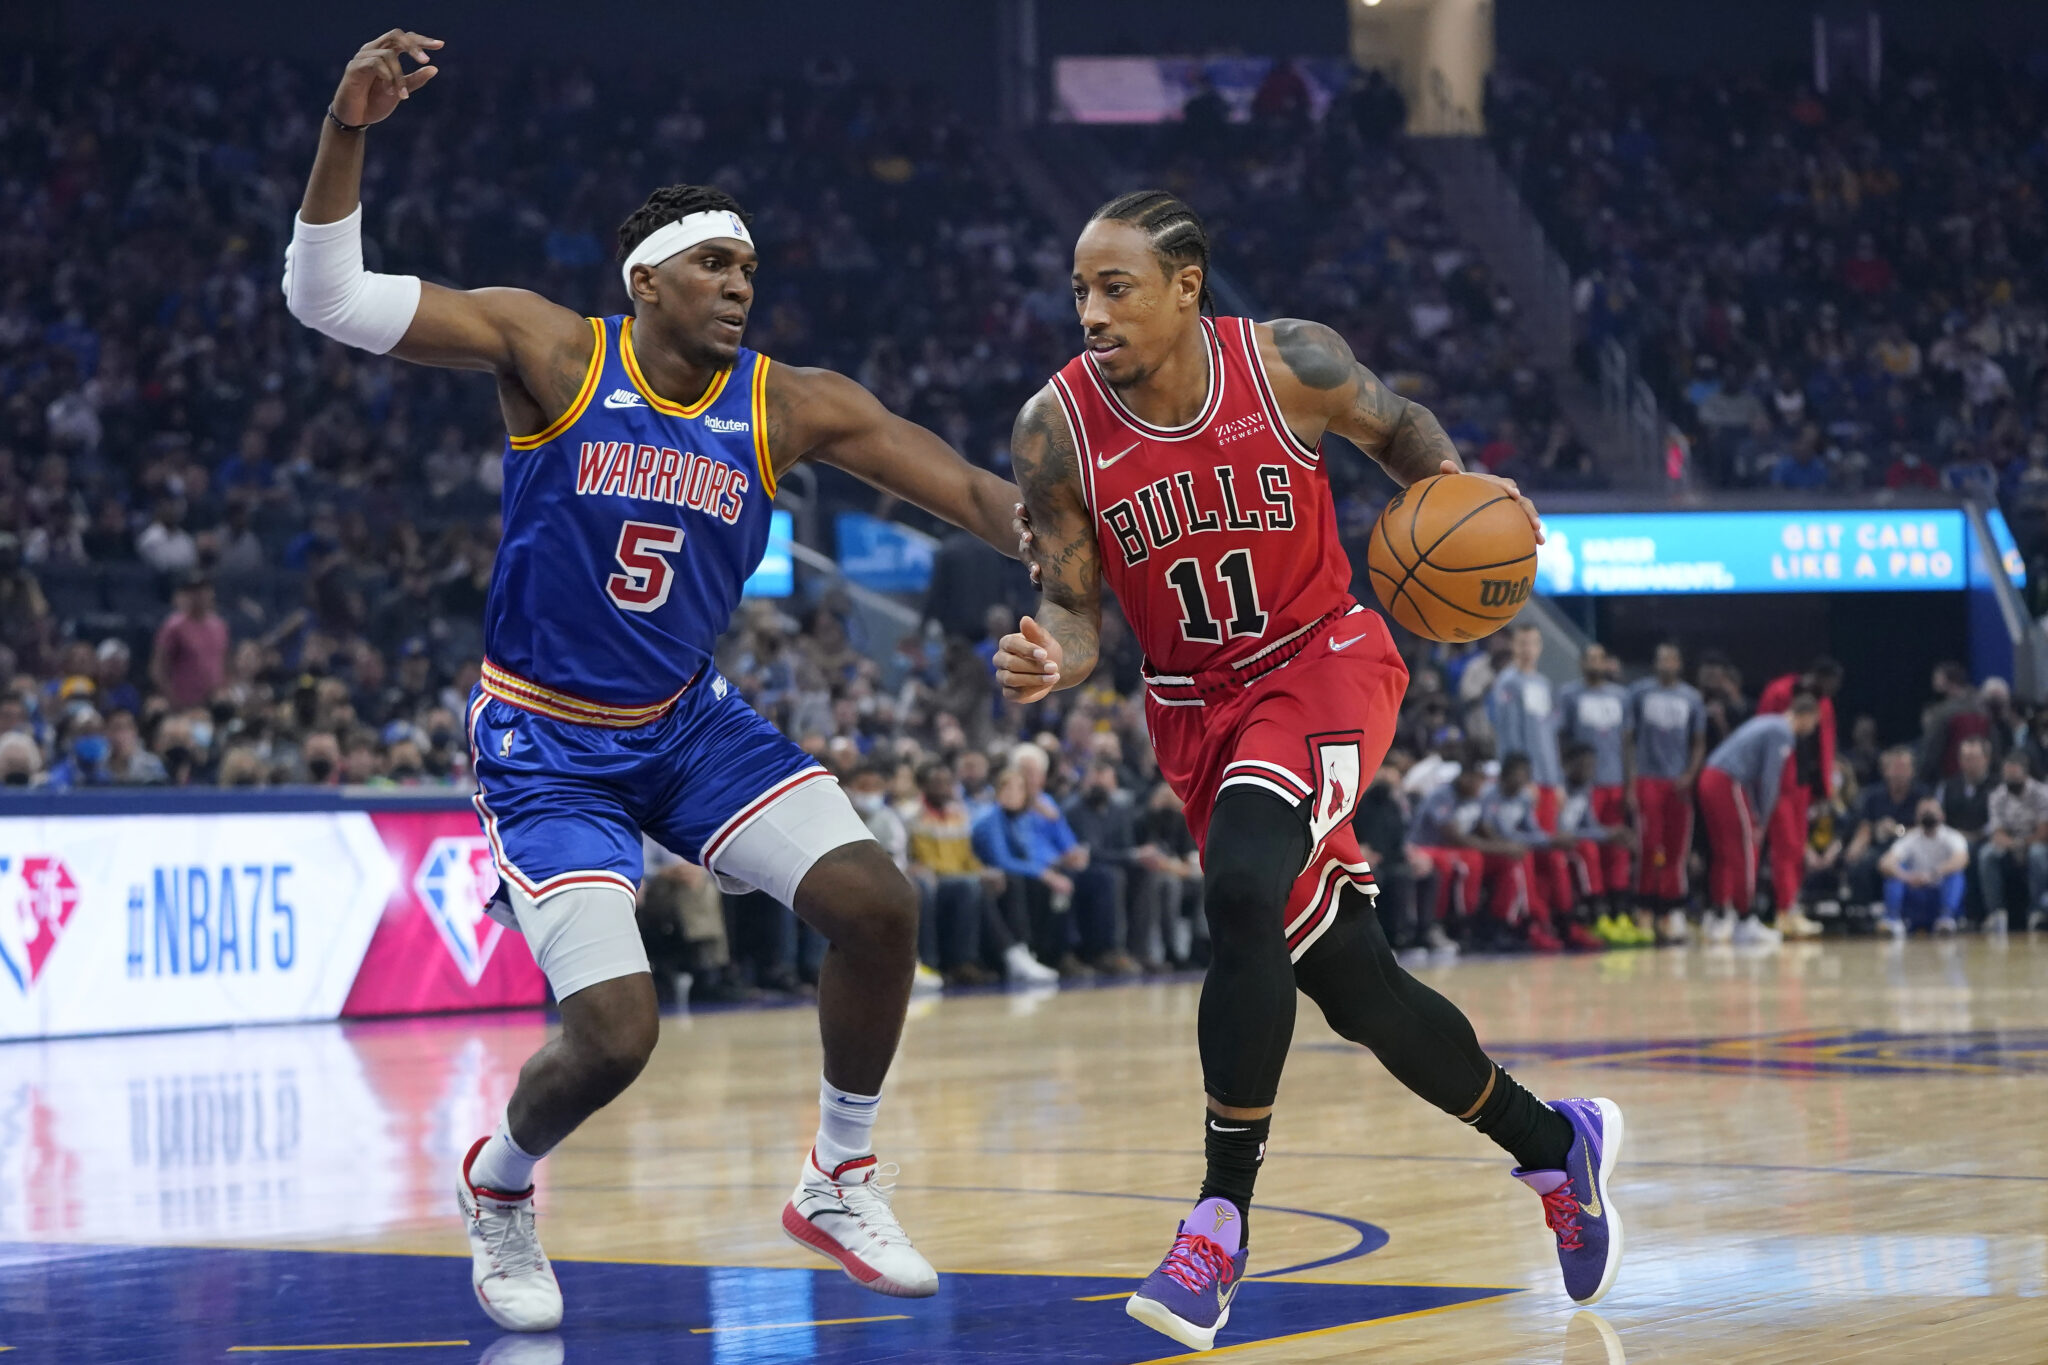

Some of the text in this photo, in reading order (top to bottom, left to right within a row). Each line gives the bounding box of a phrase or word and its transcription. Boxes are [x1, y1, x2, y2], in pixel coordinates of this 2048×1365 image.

[612, 388, 641, 404] NIKE
[704, 415, 750, 433] Rakuten
[1215, 412, 1263, 438] ZENNI
[1219, 424, 1266, 446] EYEWEAR
[576, 441, 749, 525] WARRIORS
[1100, 464, 1296, 568] BULLS
[1782, 523, 1938, 551] GET CARE
[606, 520, 685, 613] 5
[1772, 550, 1954, 581] LIKE A PRO
[1165, 548, 1269, 645] 11
[126, 866, 296, 979] #NBA75
